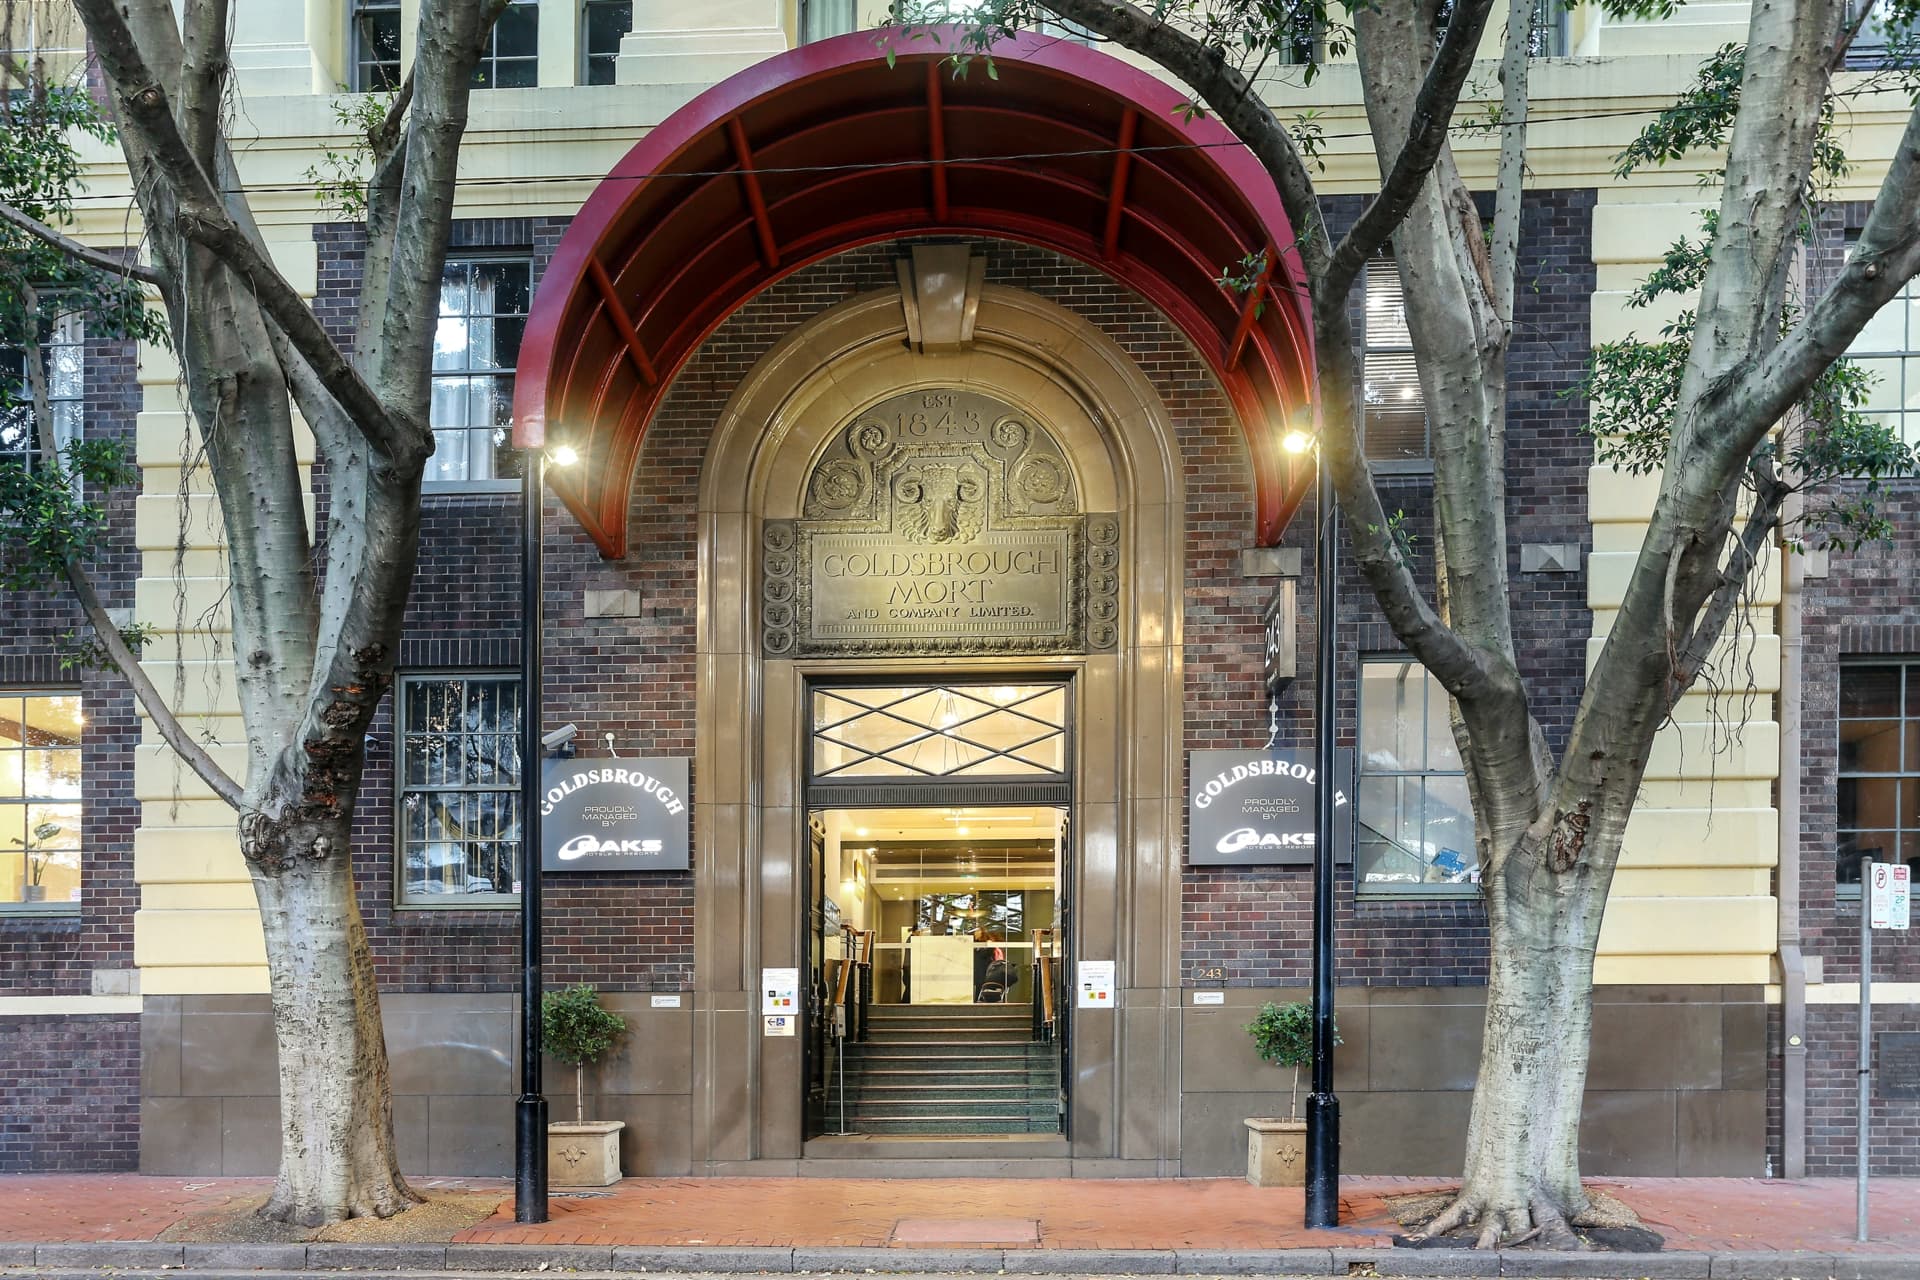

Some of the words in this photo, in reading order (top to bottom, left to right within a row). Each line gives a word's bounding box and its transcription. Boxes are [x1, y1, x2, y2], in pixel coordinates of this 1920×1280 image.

[897, 411, 980, 437] 1843
[824, 550, 1059, 577] GOLDSBROUGH
[886, 579, 993, 604] MORT
[846, 608, 879, 619] AND
[889, 607, 960, 619] COMPANY
[1265, 613, 1280, 667] 243
[541, 768, 685, 816] GOLDSBROUGH
[558, 834, 663, 860] OAKS
[1199, 968, 1222, 978] 243
